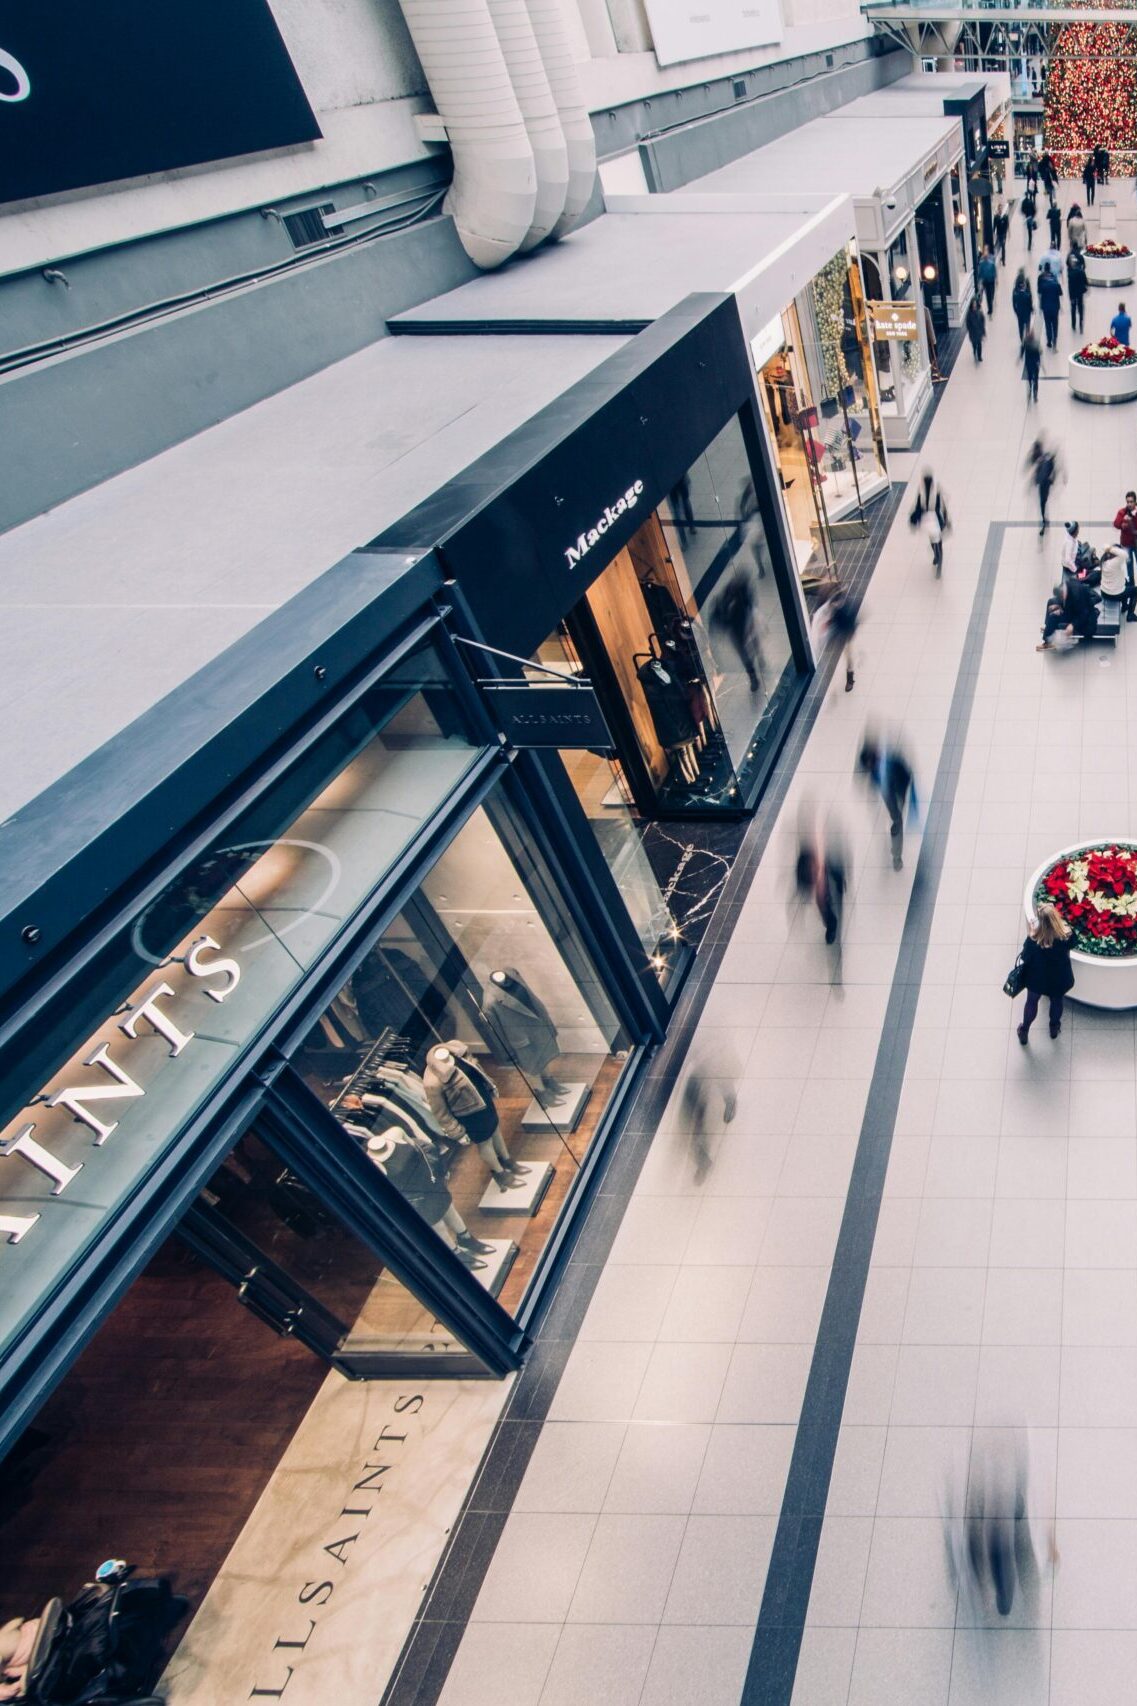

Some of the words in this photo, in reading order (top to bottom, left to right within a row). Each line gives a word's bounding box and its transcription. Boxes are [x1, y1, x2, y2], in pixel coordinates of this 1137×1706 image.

[894, 320, 917, 332] spade
[564, 480, 643, 570] Mackage
[663, 844, 695, 907] ackage
